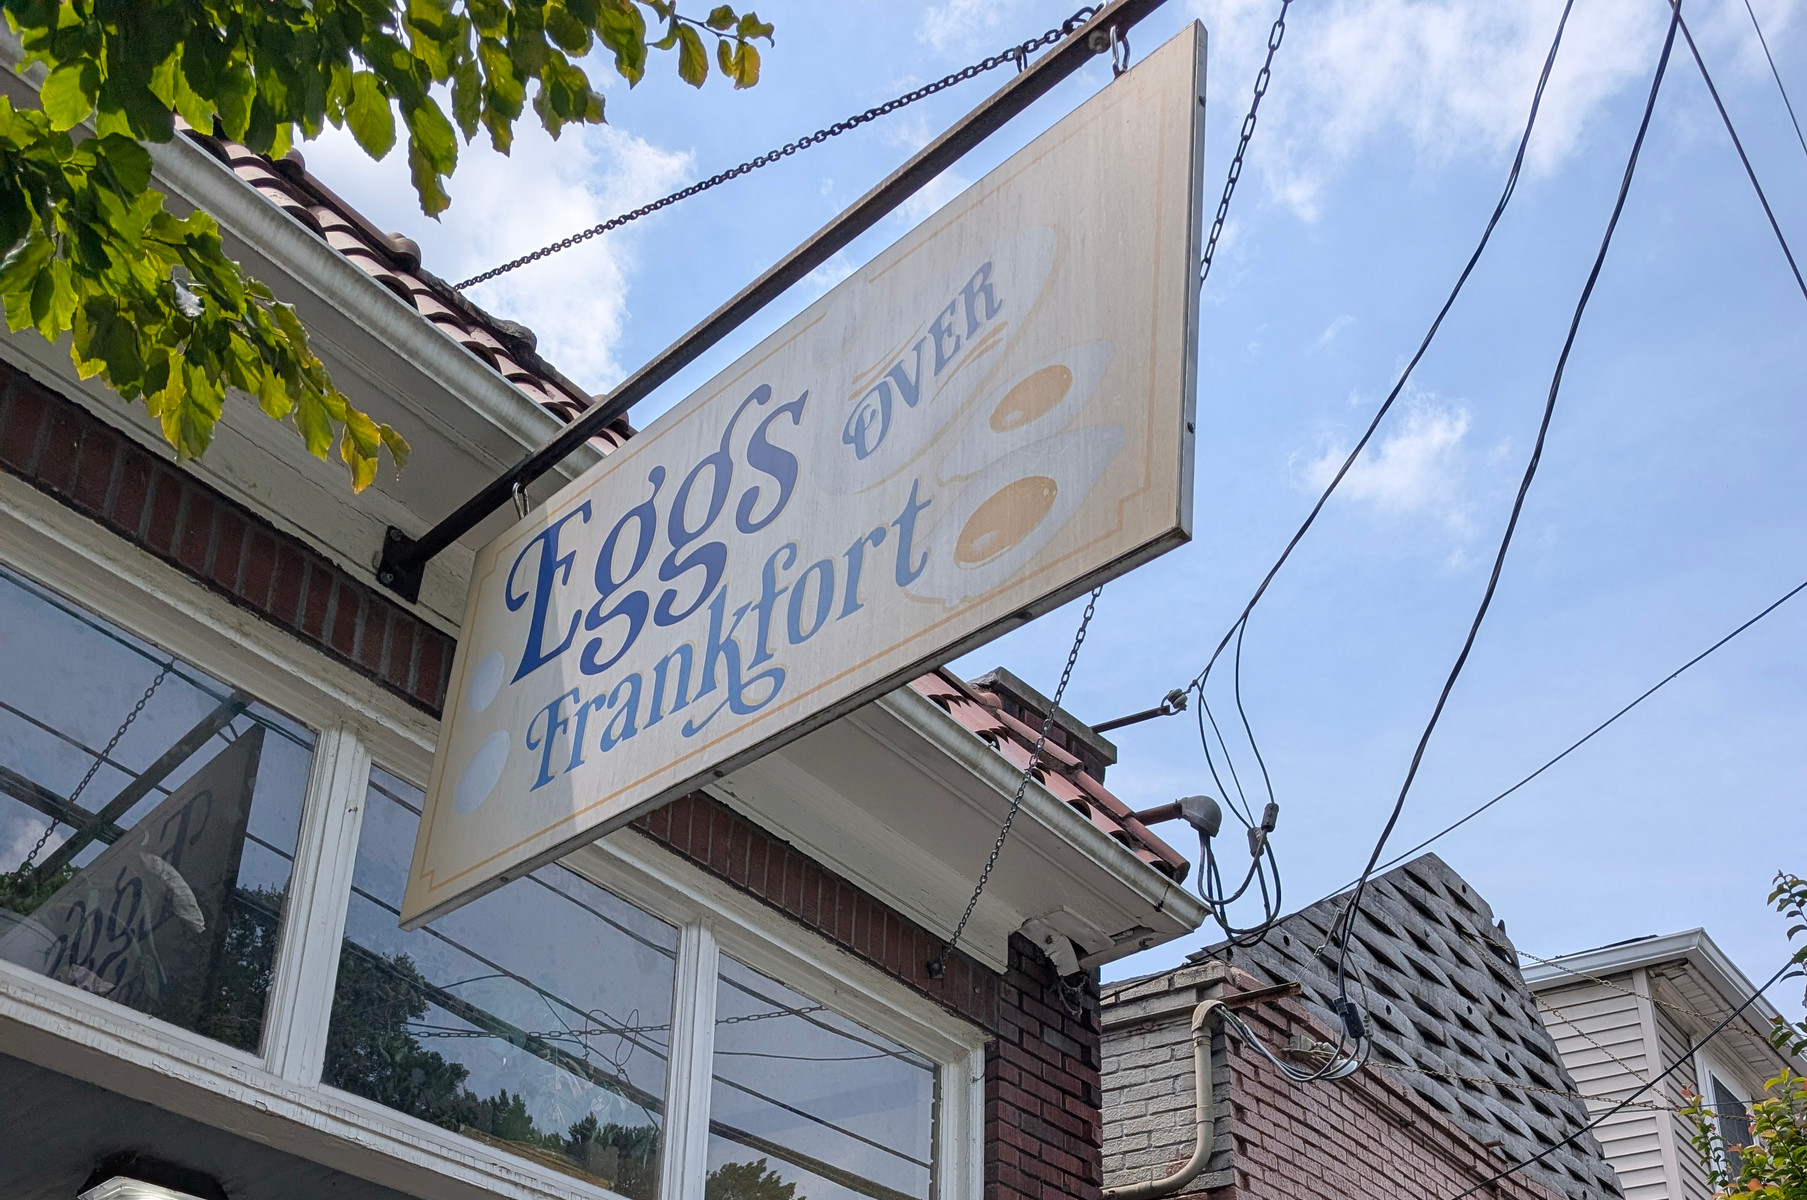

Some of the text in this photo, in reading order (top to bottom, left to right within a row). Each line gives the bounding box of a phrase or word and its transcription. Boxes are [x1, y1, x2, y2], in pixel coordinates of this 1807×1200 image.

[505, 260, 1003, 685] Eggs OVER
[526, 479, 932, 793] Frankfort
